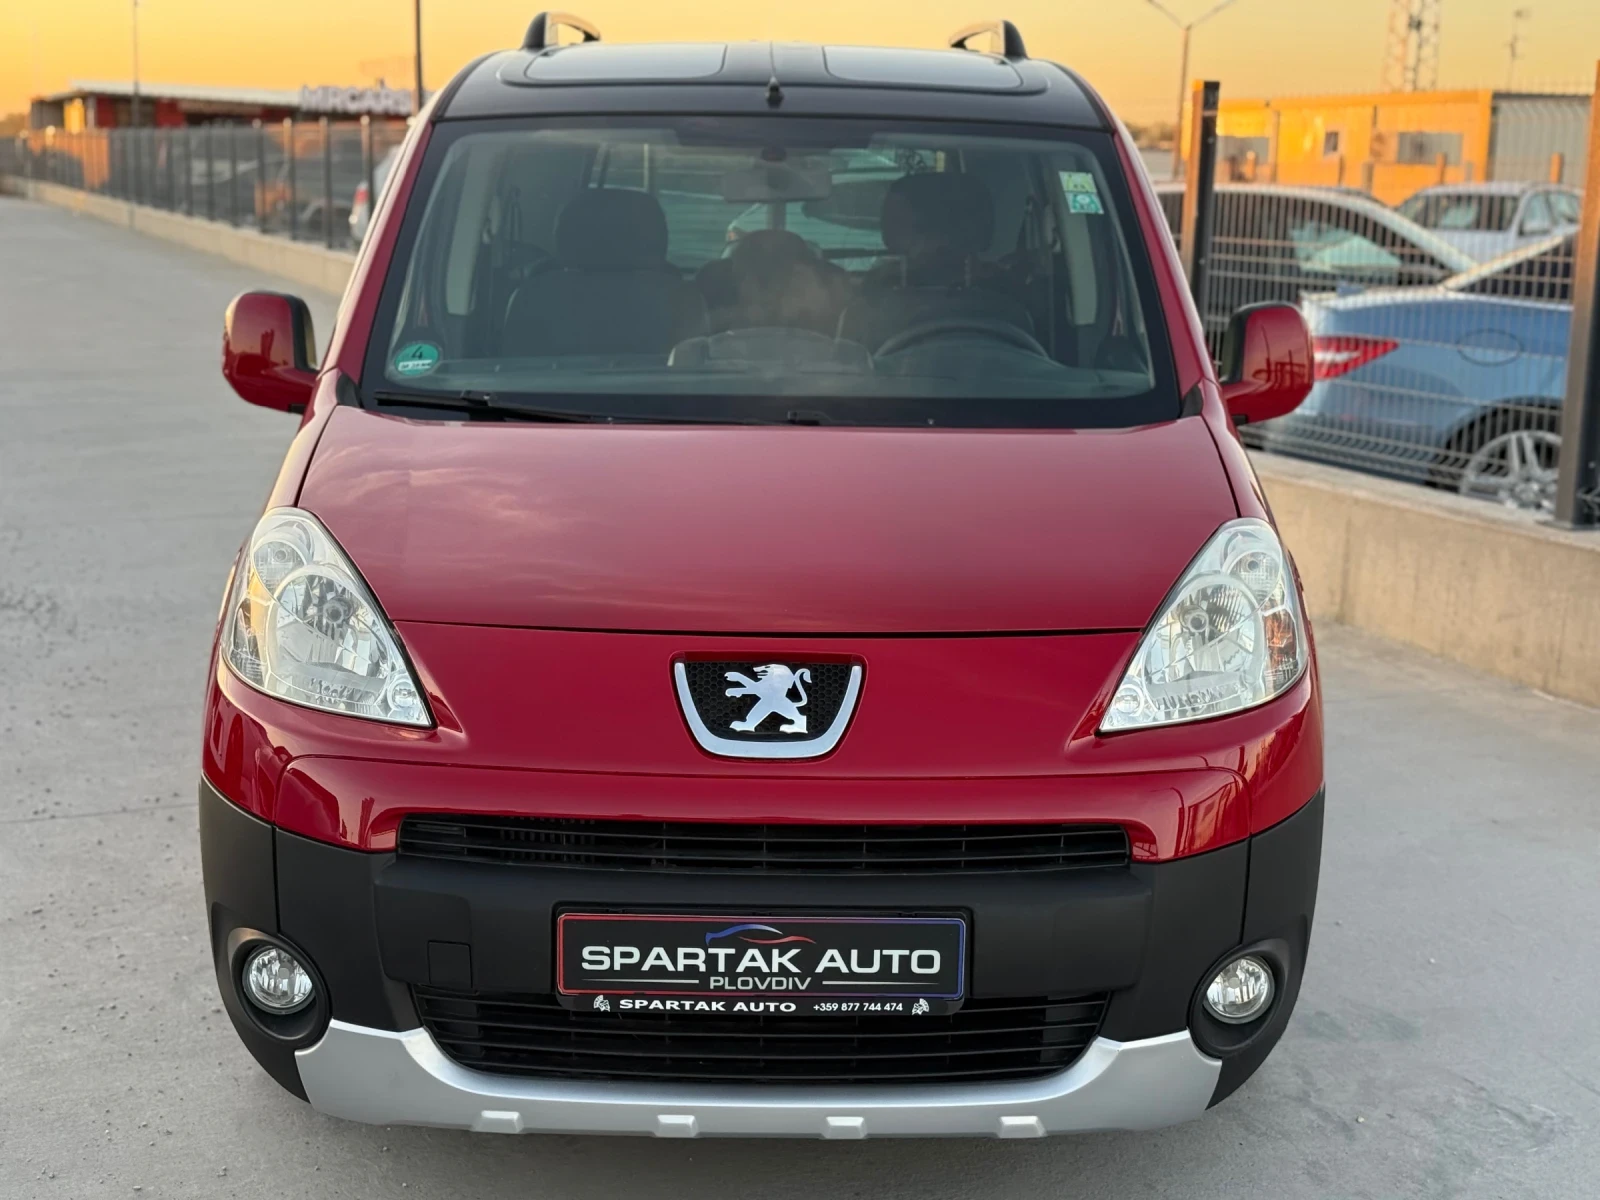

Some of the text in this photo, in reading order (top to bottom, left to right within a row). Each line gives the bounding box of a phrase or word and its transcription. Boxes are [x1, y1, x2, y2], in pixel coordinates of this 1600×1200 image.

[411, 346, 424, 360] 4
[581, 945, 942, 974] SPARTAK AUTO
[709, 976, 812, 990] PLOVDIV
[619, 999, 904, 1013] SPARTAK AUTO +359 877 744 474
